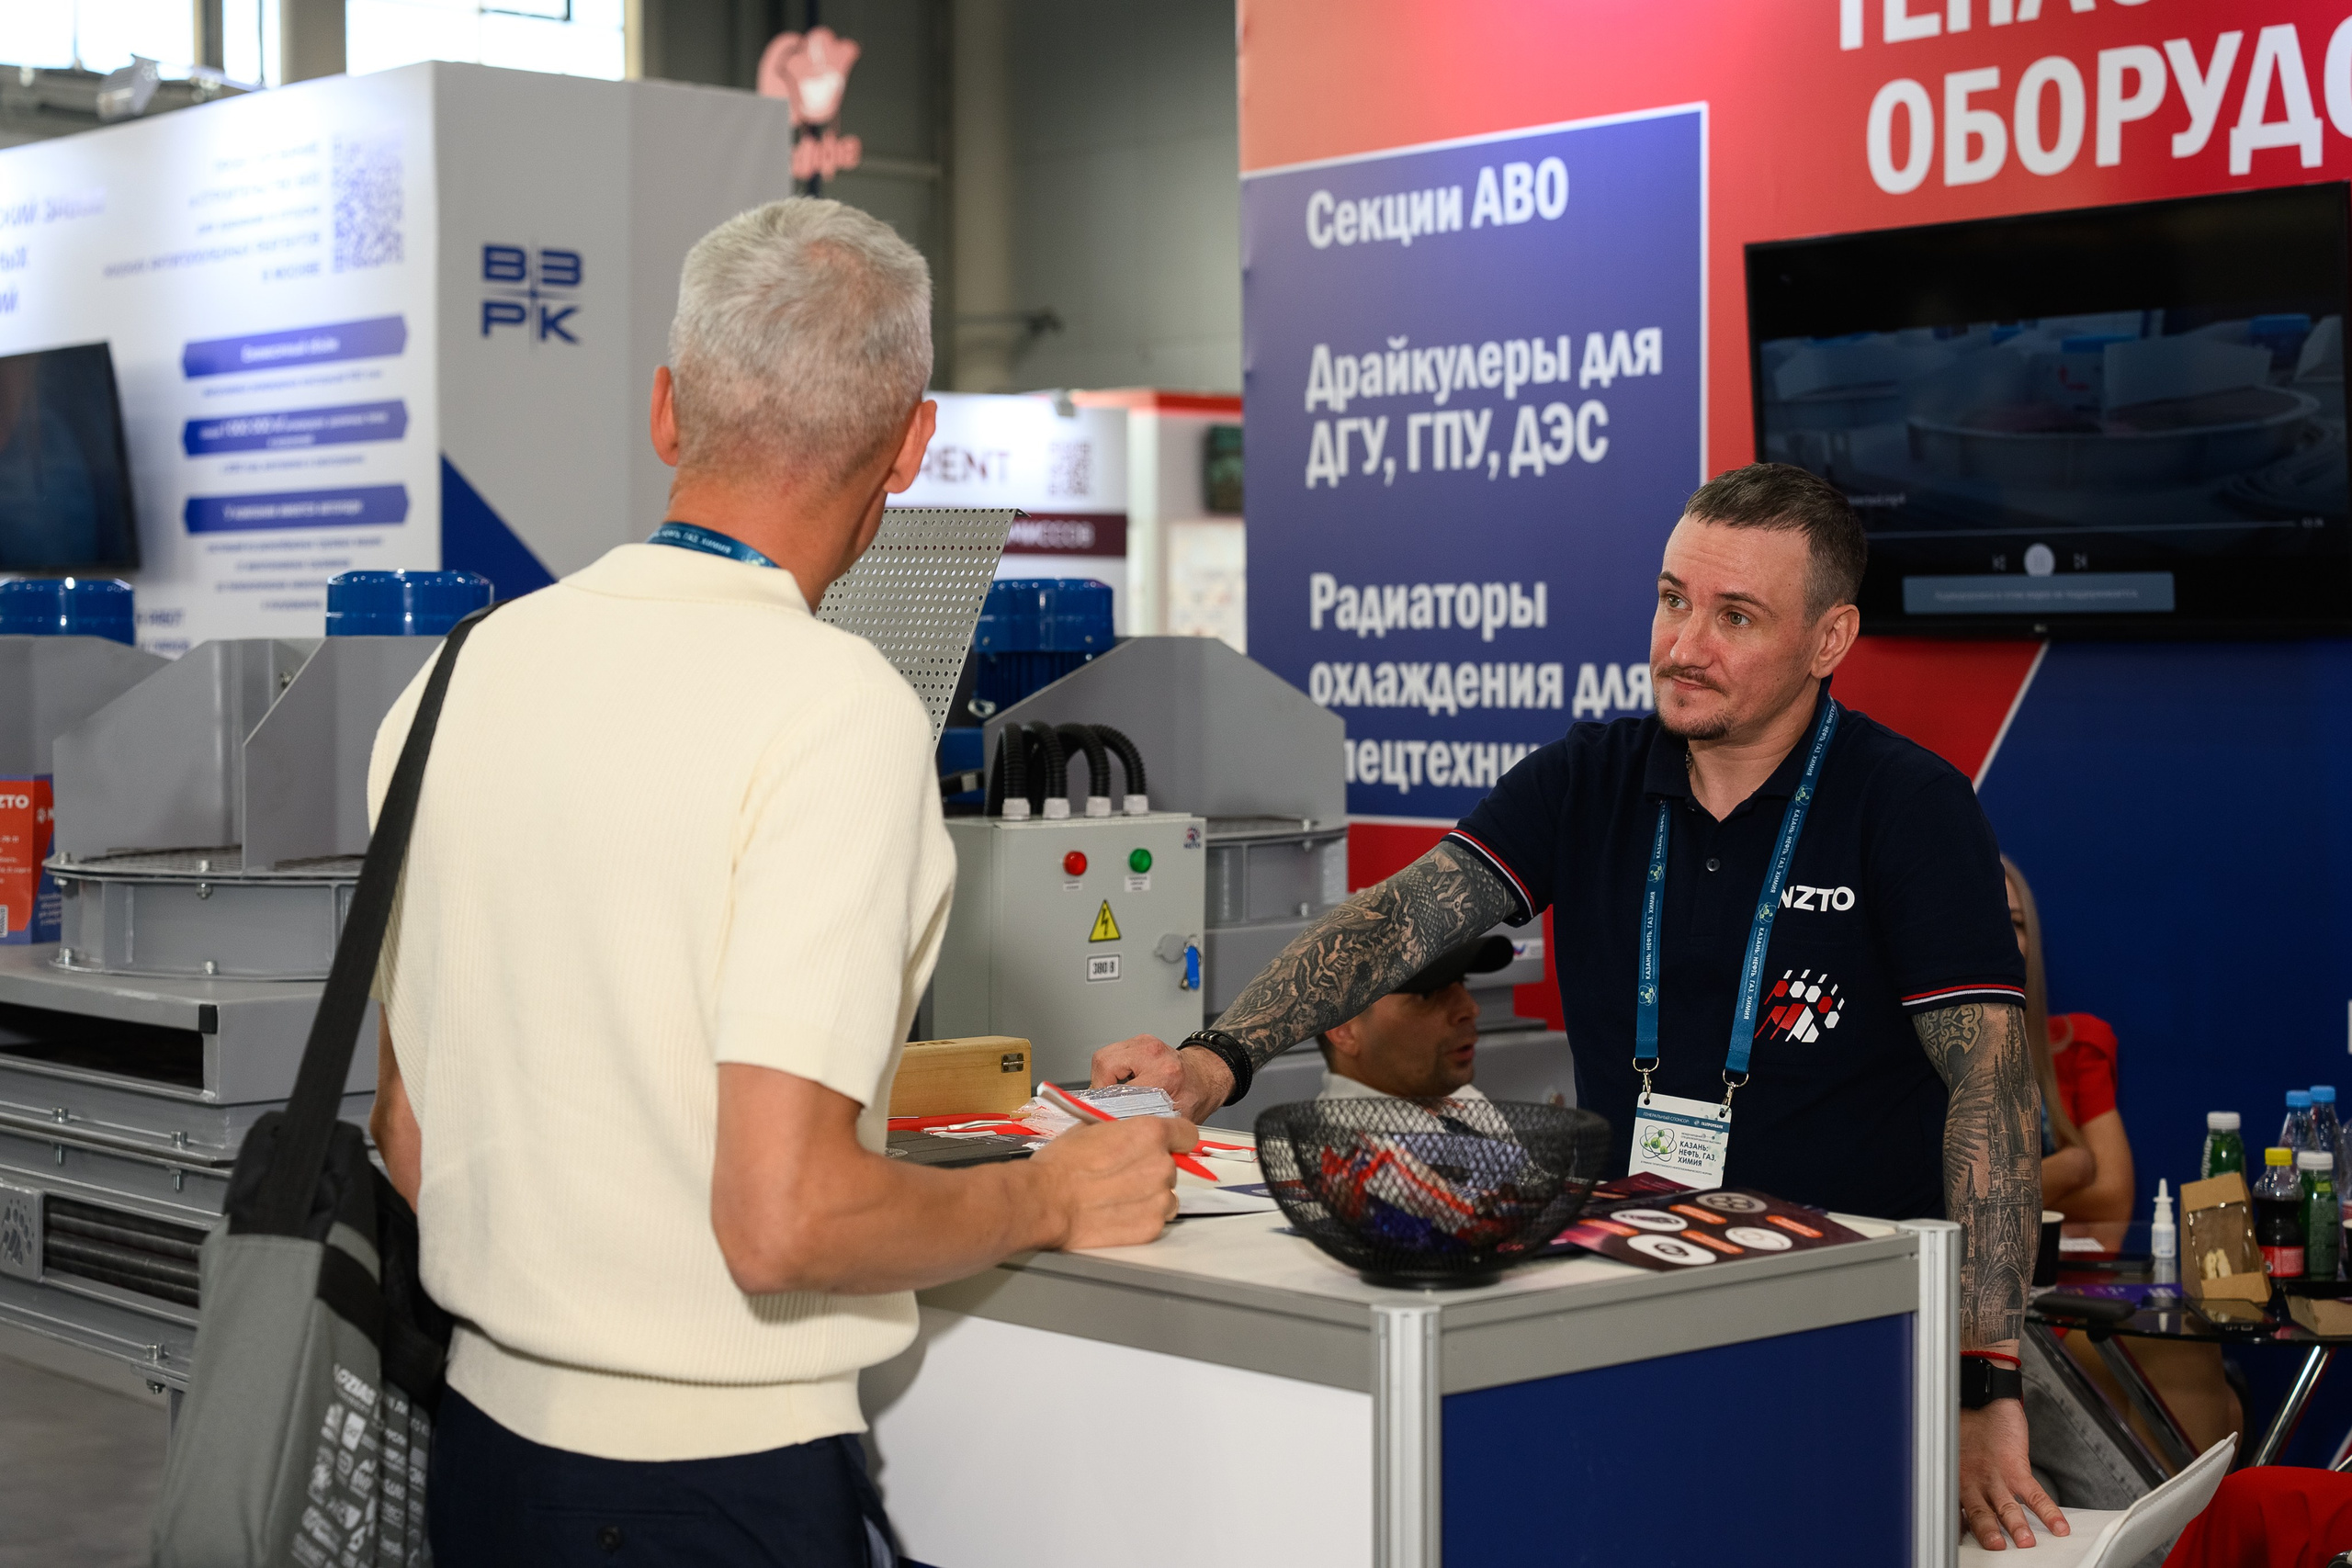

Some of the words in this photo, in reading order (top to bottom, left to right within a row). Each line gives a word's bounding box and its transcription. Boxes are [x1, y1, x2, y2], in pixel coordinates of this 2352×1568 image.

[1306, 186, 1464, 248] Секции
[1471, 156, 1569, 229] АВО
[1305, 334, 1571, 412] Драйкулеры
[1578, 327, 1662, 390] для
[1306, 414, 1396, 489] ДГУ,
[1407, 407, 1500, 481] ГПУ,
[1509, 399, 1609, 479] ДЭС
[1309, 571, 1547, 642] Радиаторы
[1309, 661, 1563, 717] охлаждения
[1572, 662, 1652, 719] для
[1778, 885, 1856, 912] NZTO
[1092, 962, 1107, 975] 380
[1744, 995, 1753, 1020] ХИМИЯ
[1679, 1141, 1709, 1152] КАЗАНЬ:
[1679, 1148, 1701, 1159] НЕФТЬ,
[1702, 1153, 1716, 1162] ГАЗ,
[1678, 1156, 1702, 1167] ХИМИЯ
